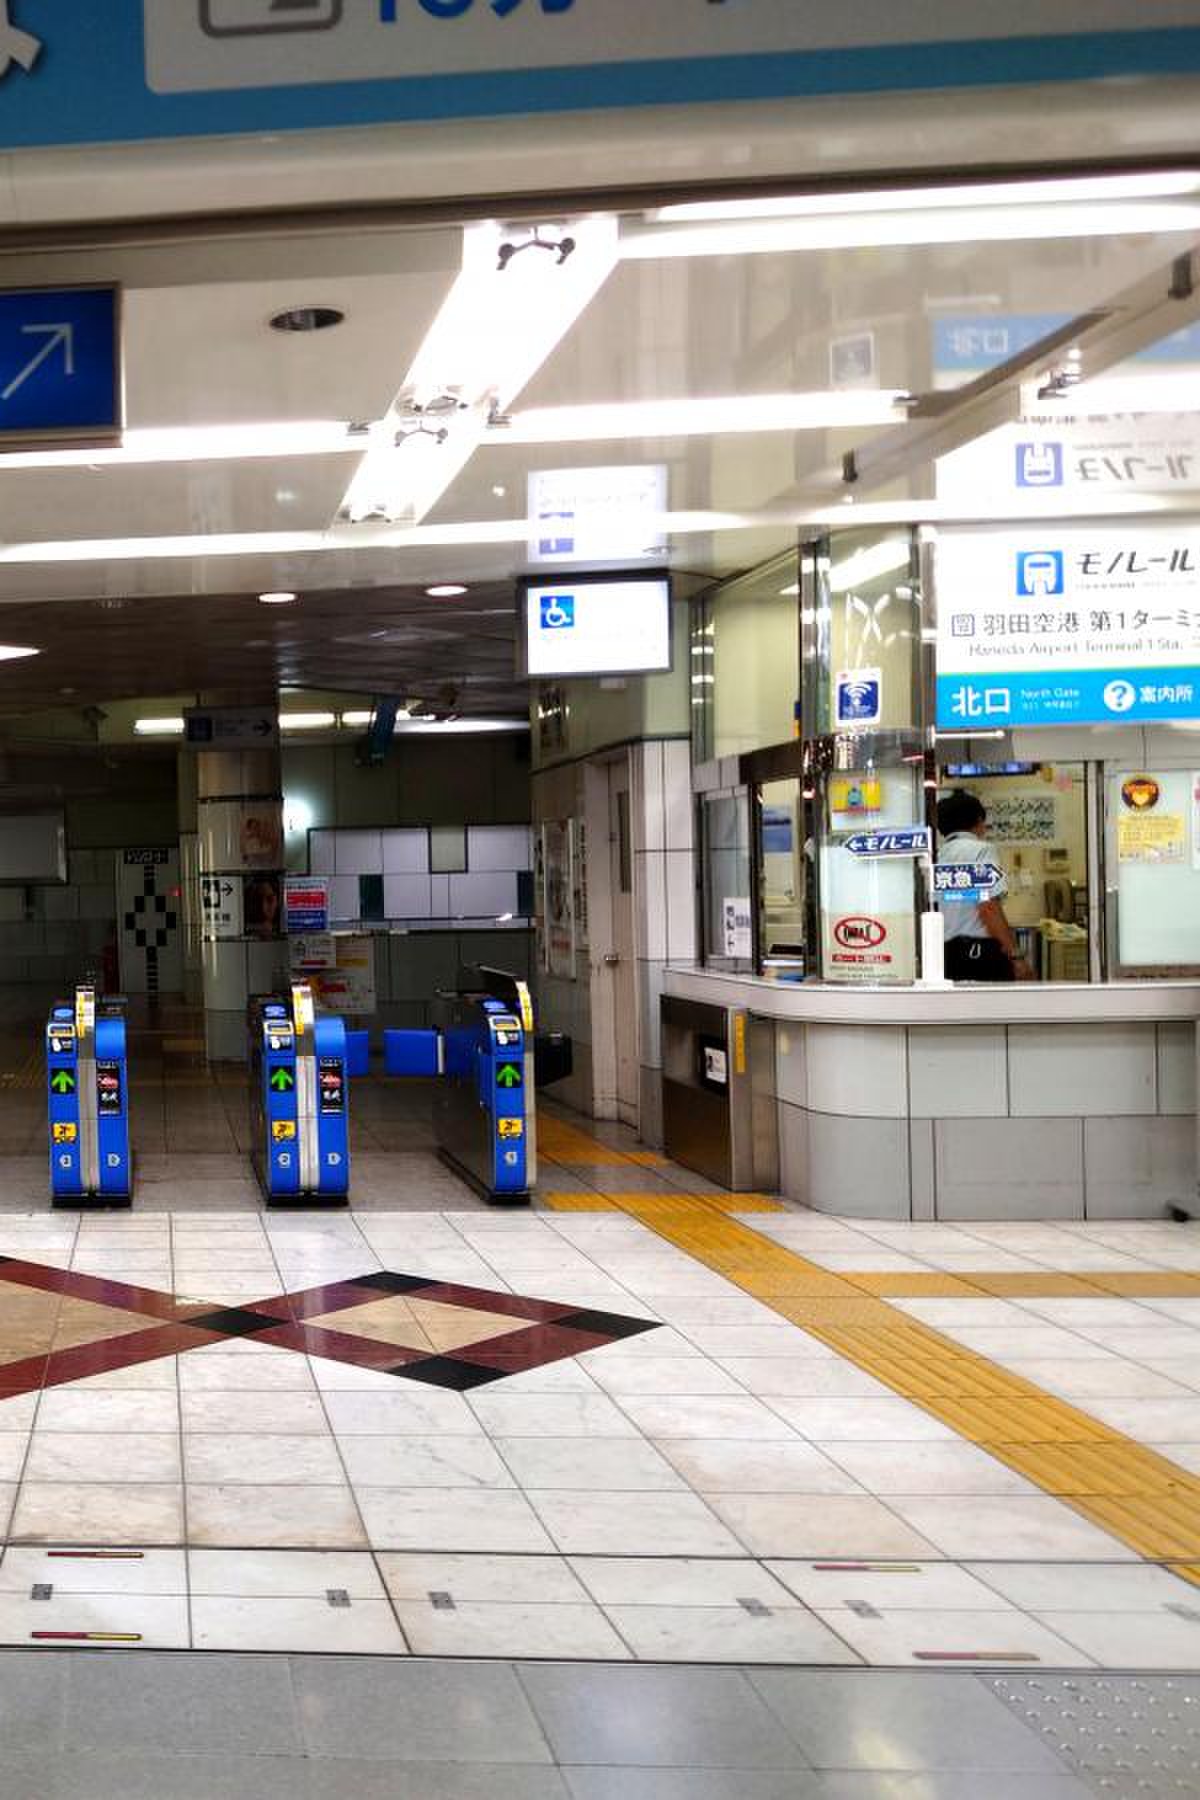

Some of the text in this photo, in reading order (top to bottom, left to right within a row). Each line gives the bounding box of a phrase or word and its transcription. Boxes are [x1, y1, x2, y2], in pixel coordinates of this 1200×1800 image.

[1075, 548, 1196, 575] モノレール
[983, 611, 1081, 637] 羽田空港
[951, 685, 1011, 717] 北口
[1139, 684, 1194, 704] 案内所
[865, 833, 926, 850] モノレール
[935, 870, 973, 890] 京急
